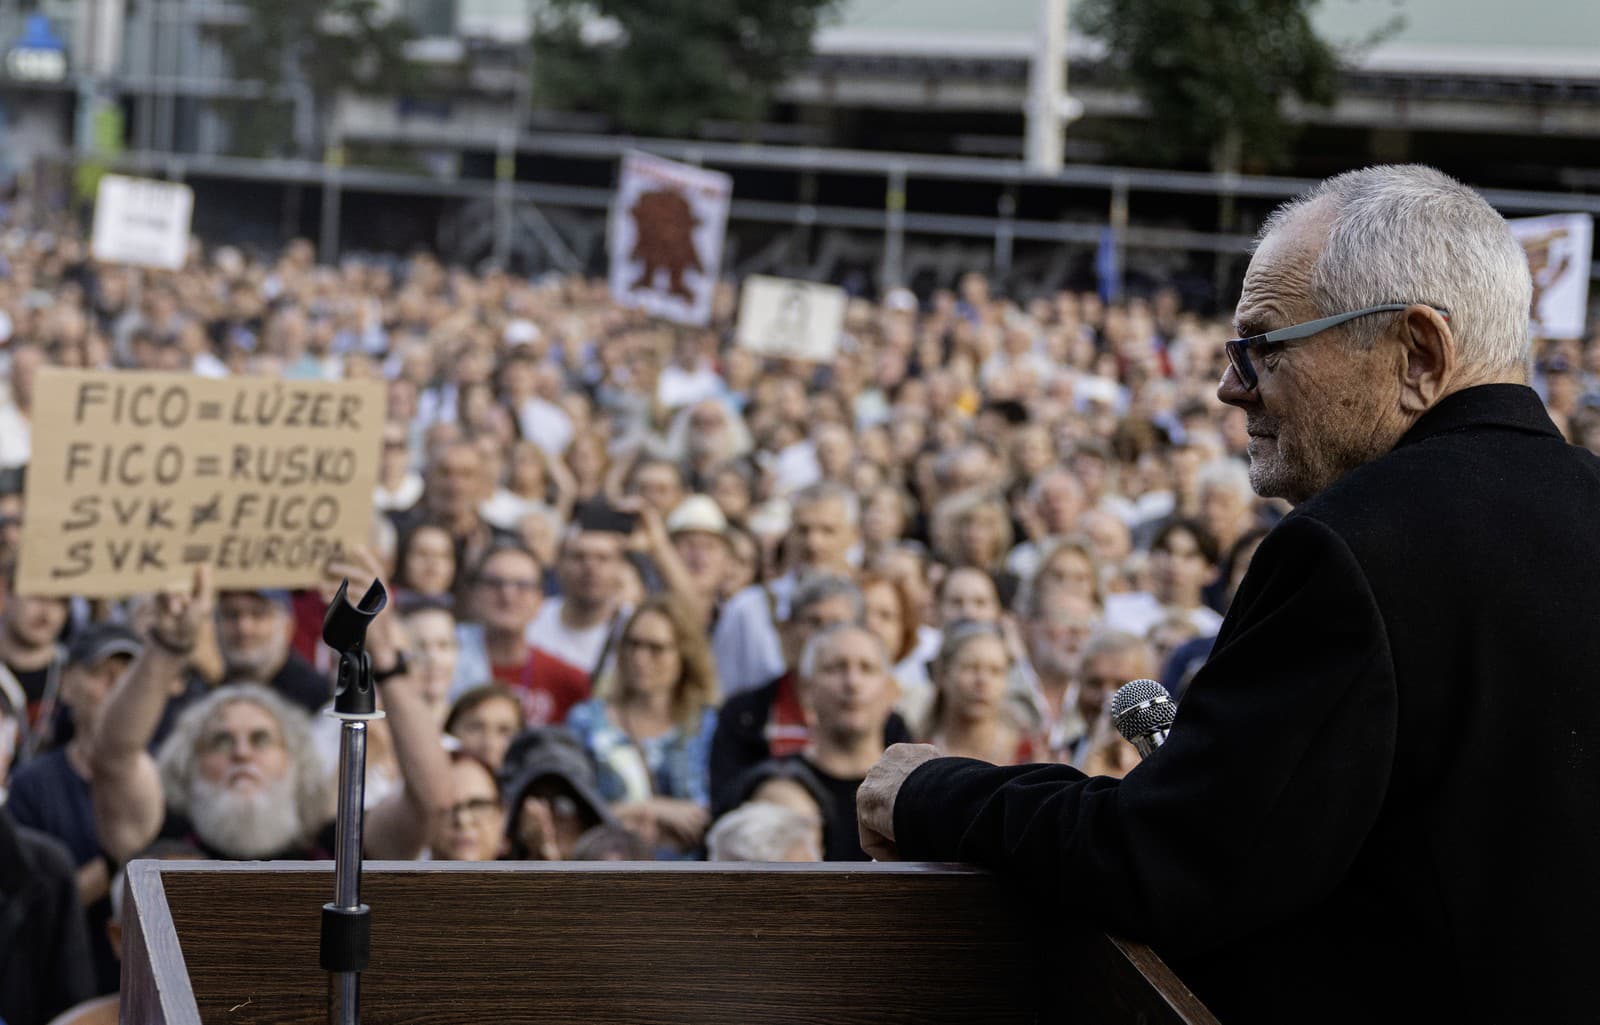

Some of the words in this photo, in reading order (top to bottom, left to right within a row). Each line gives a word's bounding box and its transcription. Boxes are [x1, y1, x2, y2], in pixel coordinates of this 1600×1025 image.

[74, 382, 191, 429] FICO
[63, 443, 184, 486] FICO
[229, 444, 356, 486] RUSKO
[61, 496, 174, 532] SVK
[230, 495, 341, 531] FICO
[50, 541, 167, 579] SVK
